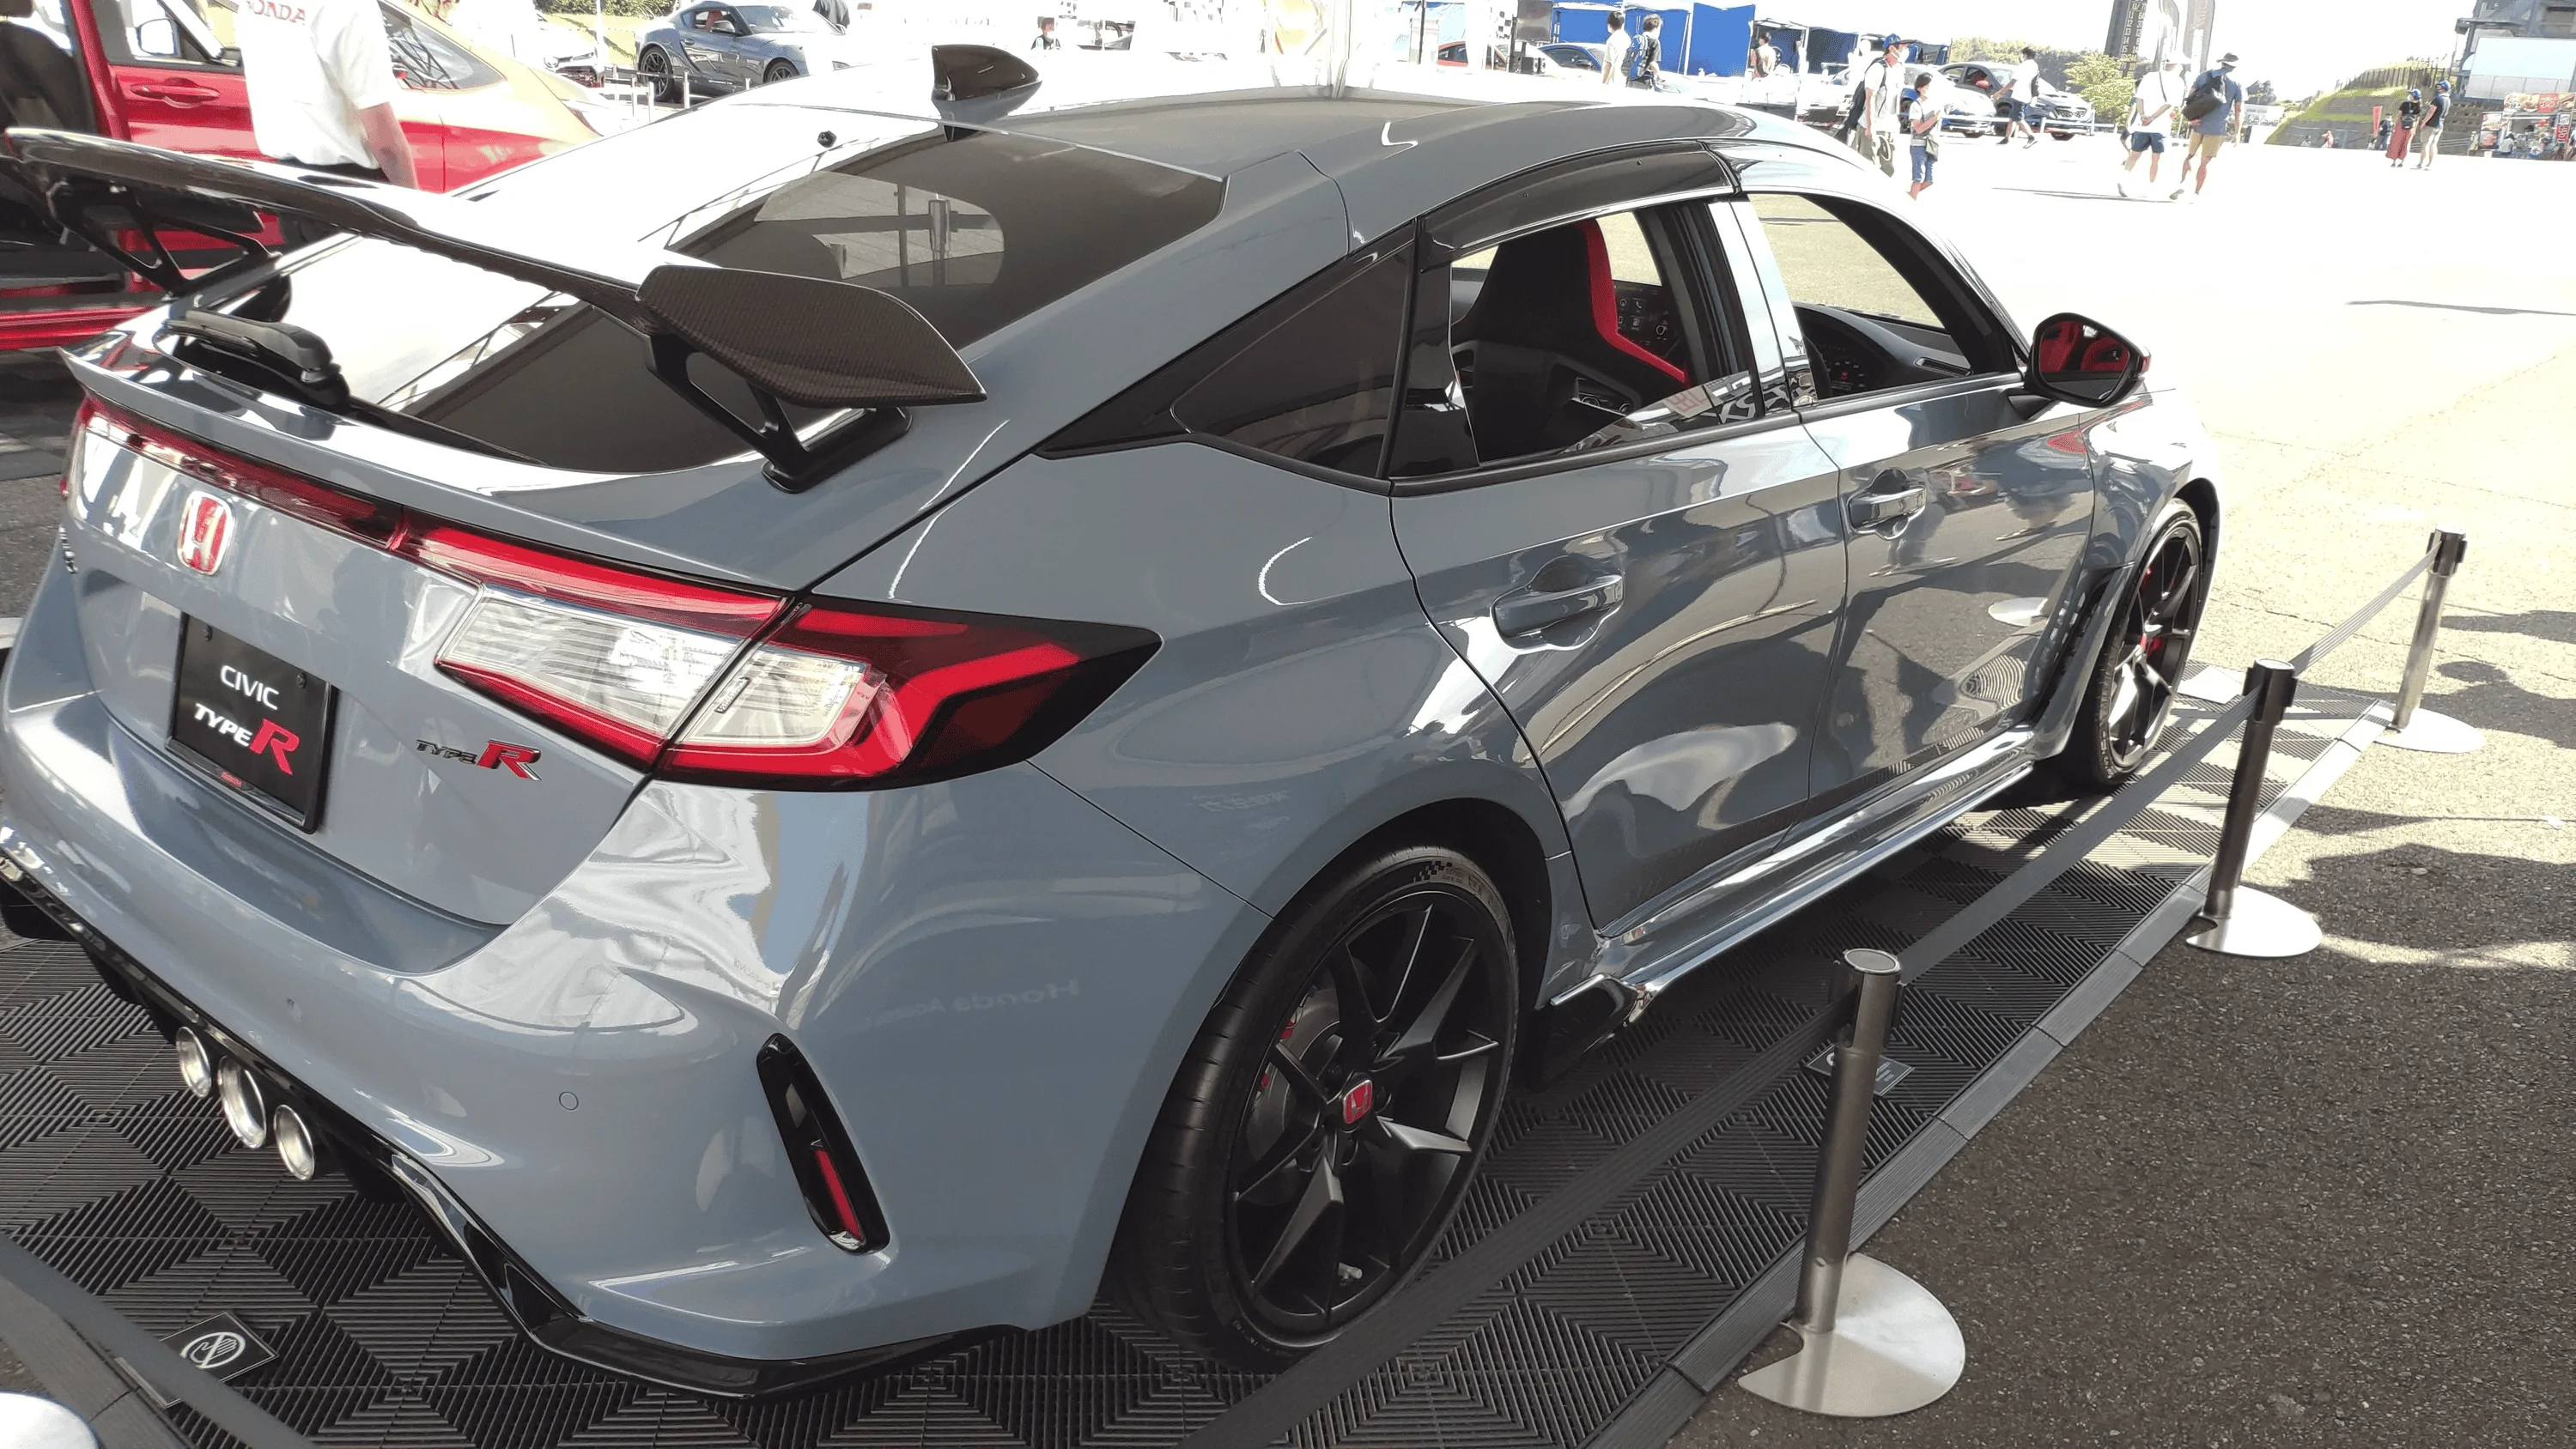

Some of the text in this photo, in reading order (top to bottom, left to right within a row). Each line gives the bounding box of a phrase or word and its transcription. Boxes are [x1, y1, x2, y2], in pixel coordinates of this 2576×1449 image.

[246, 0, 305, 25] ONDA
[220, 664, 279, 711] CIVIC
[193, 702, 301, 777] TYPE R
[416, 738, 543, 781] TYPE R
